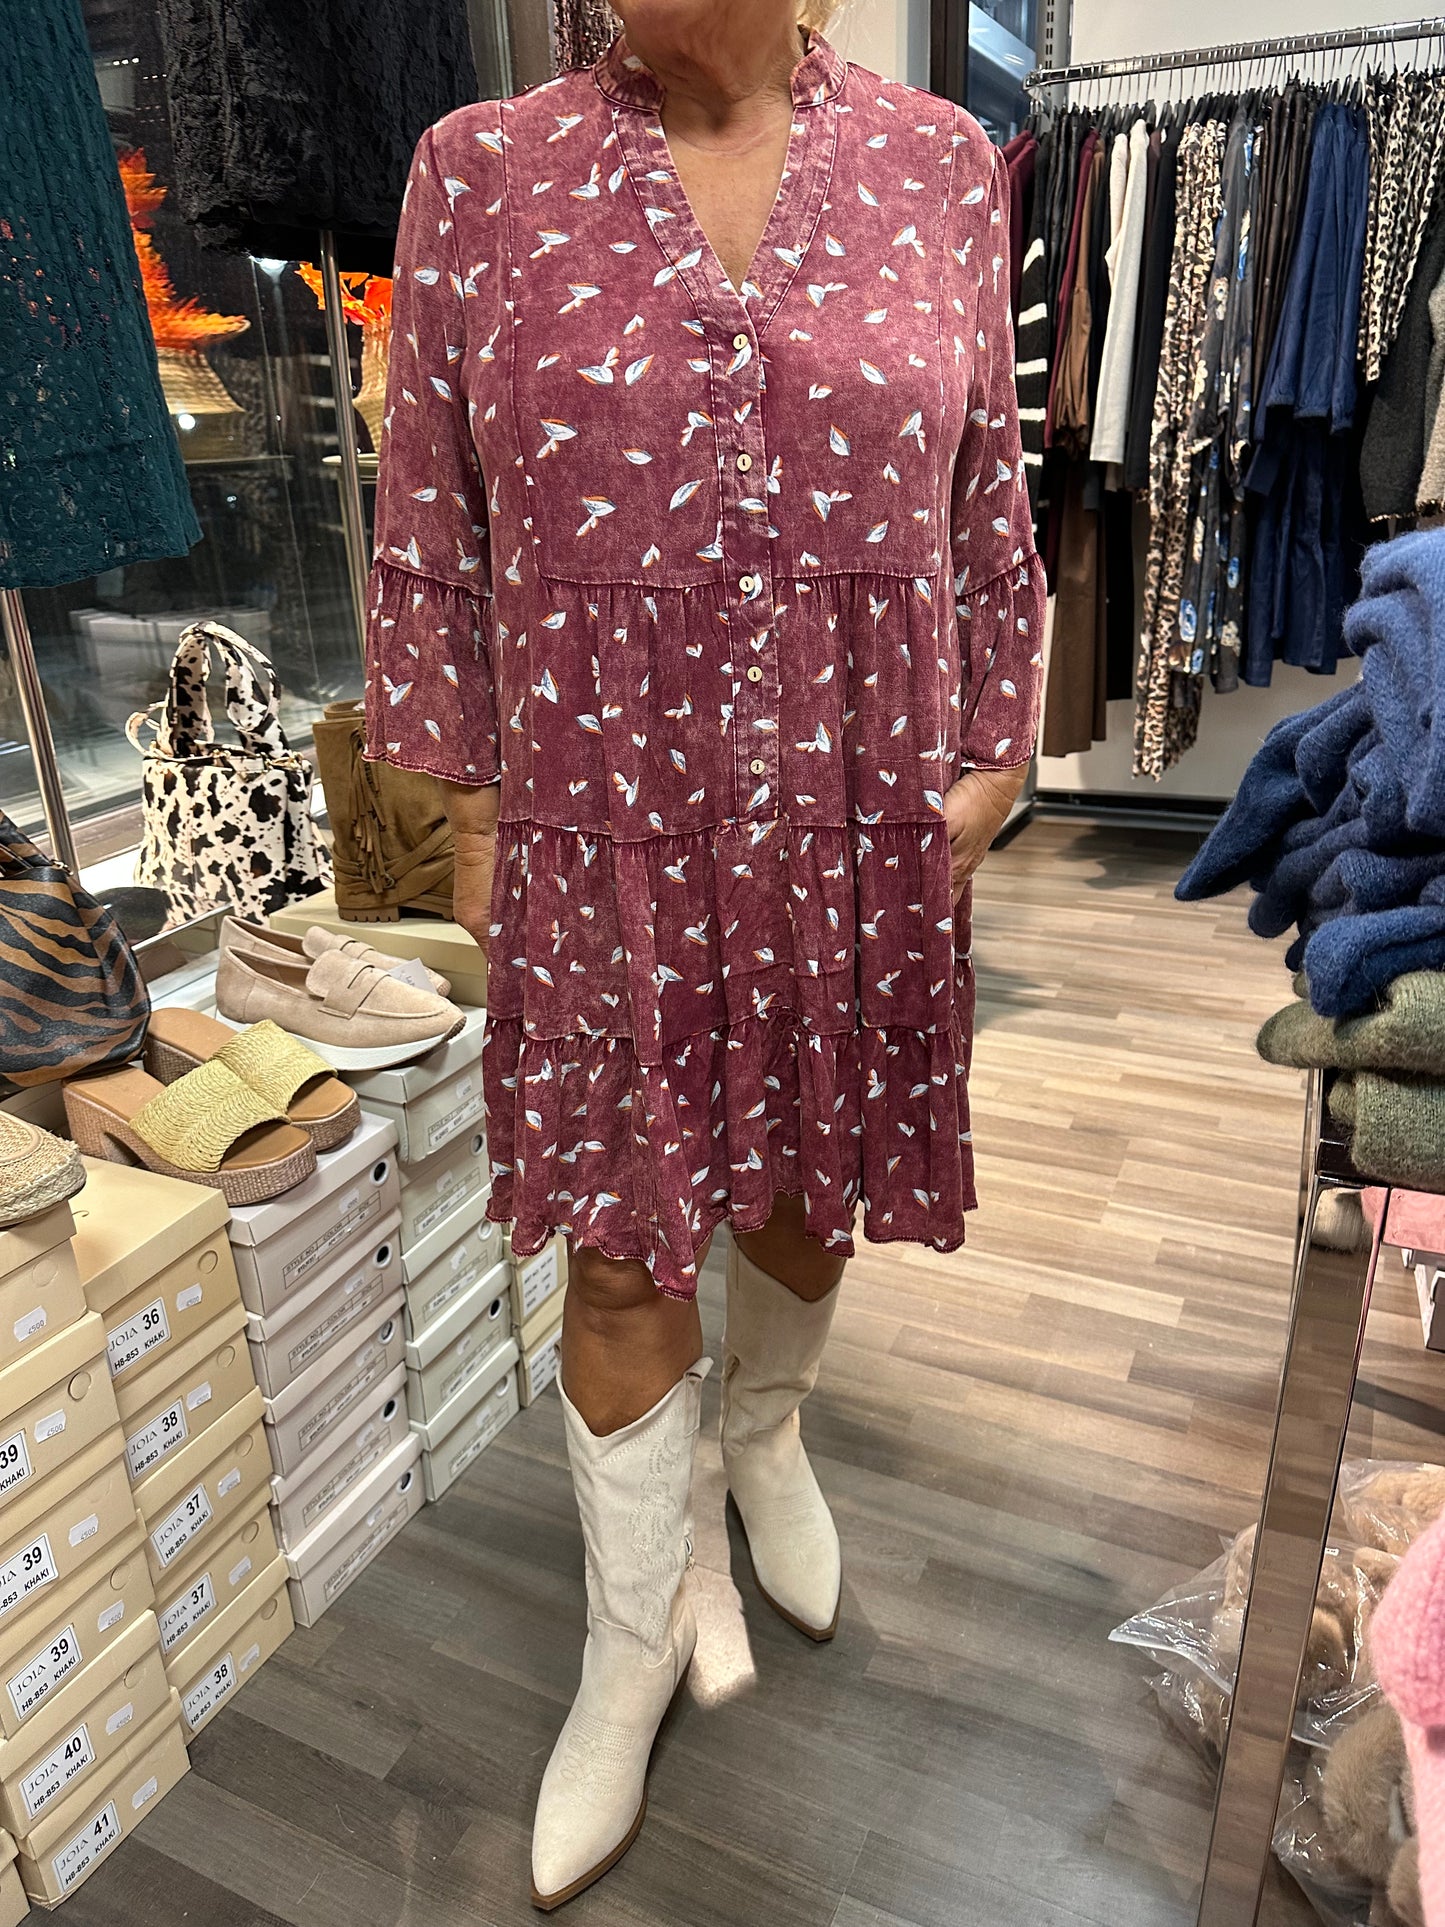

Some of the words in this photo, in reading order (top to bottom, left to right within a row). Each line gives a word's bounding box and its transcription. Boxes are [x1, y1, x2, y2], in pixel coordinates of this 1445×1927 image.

[109, 1327, 138, 1352] JOIA
[142, 1308, 160, 1330] 36
[144, 1329, 165, 1349] KHAKI
[131, 1430, 158, 1455] JOIA
[162, 1411, 178, 1432] 38
[163, 1430, 183, 1451] KHAKI
[0, 1444, 18, 1470] 39
[0, 1467, 25, 1491] KHAKI
[159, 1517, 184, 1545] JOIA
[186, 1493, 200, 1516] 37
[190, 1510, 209, 1531] KHAKI
[0, 1570, 17, 1587] IA
[22, 1546, 42, 1571] 39
[0, 1591, 18, 1611] -853
[24, 1567, 50, 1591] KHAKI
[162, 1605, 187, 1631] JOIA
[191, 1583, 205, 1605] 37
[192, 1600, 211, 1621] KHAKI
[16, 1664, 46, 1696] JOIA
[50, 1638, 69, 1663] 39
[21, 1682, 49, 1712] H8-853
[53, 1655, 76, 1681] KHAKI
[187, 1685, 210, 1711] JOIA
[214, 1664, 228, 1685] 38
[215, 1679, 233, 1700] KHAKI
[28, 1763, 59, 1794] JOIA
[64, 1737, 82, 1760] 40
[65, 1754, 89, 1780] KHAKI
[60, 1839, 89, 1870] JOIA
[94, 1813, 110, 1836] 41
[94, 1829, 116, 1854] KHAKI
